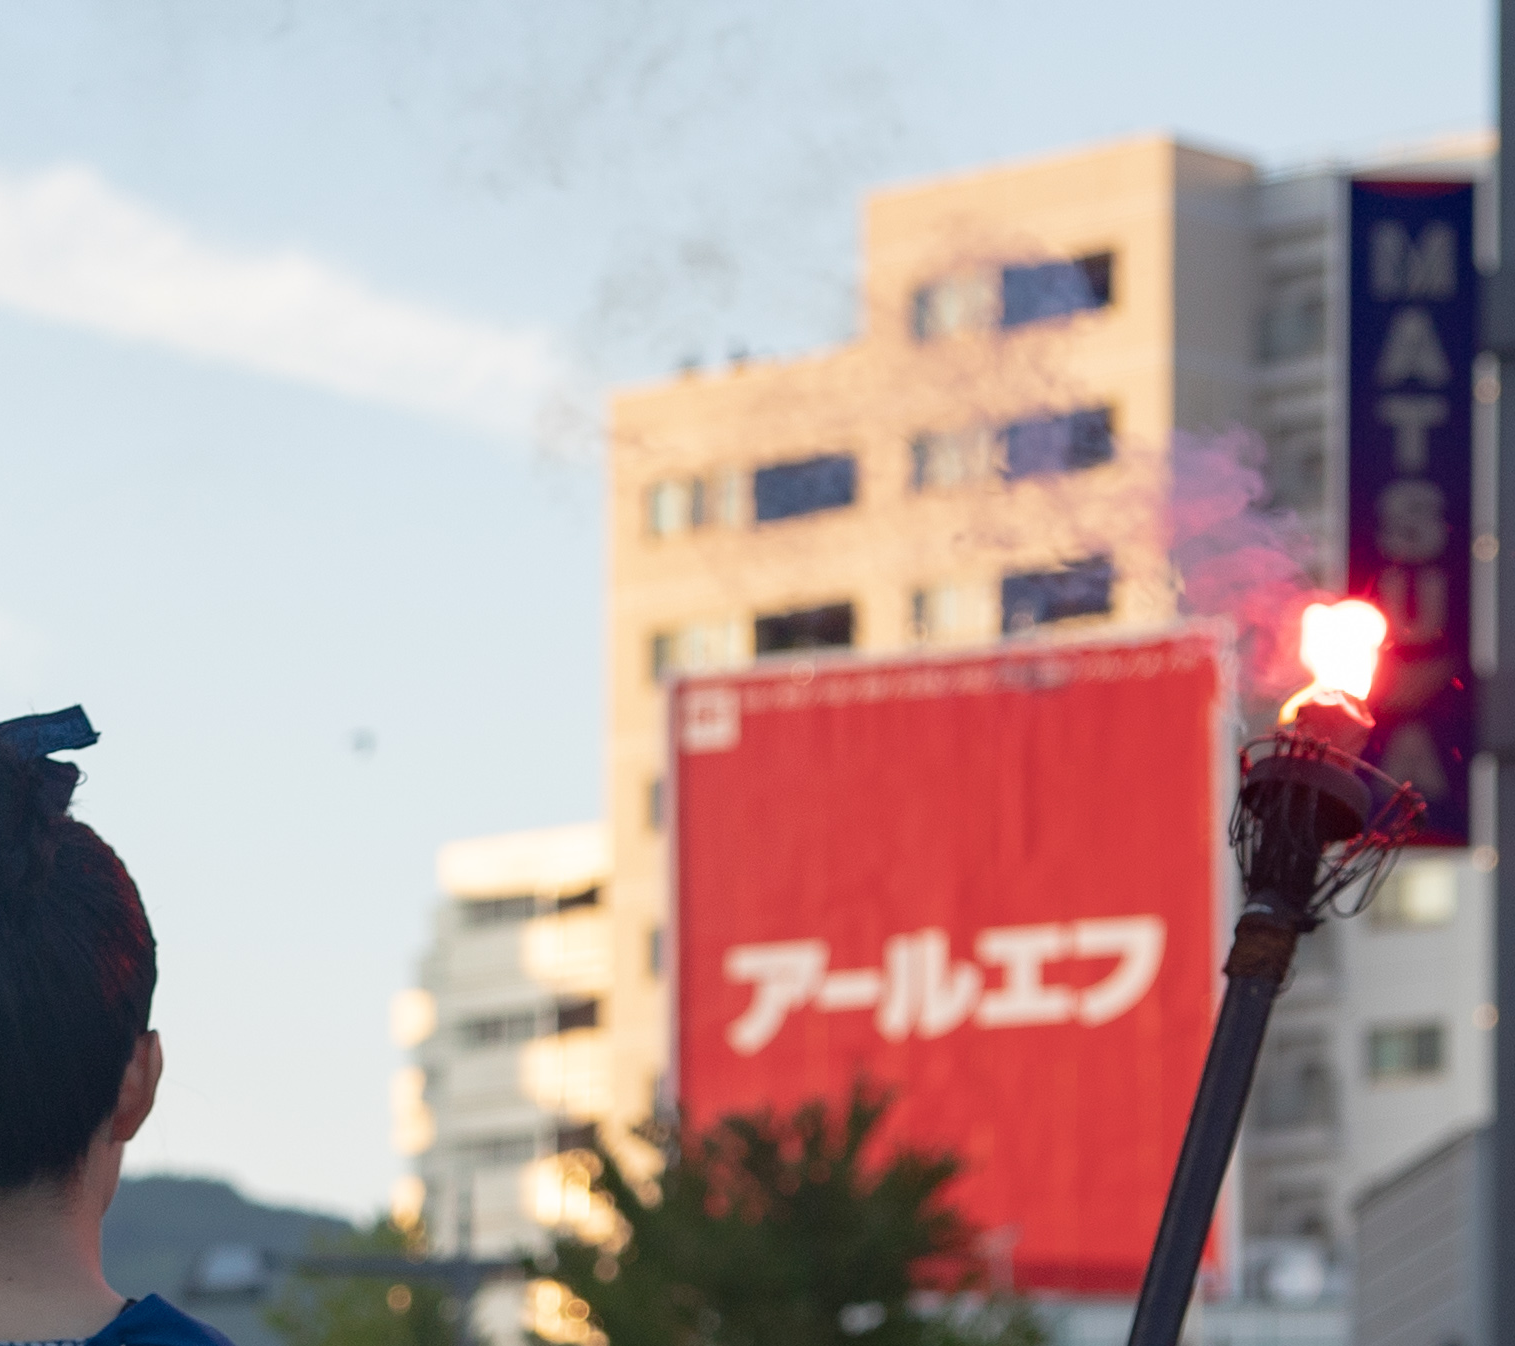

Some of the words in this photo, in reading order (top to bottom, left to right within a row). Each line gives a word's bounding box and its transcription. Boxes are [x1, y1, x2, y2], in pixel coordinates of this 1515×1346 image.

[725, 916, 1164, 1055] アールエフ
